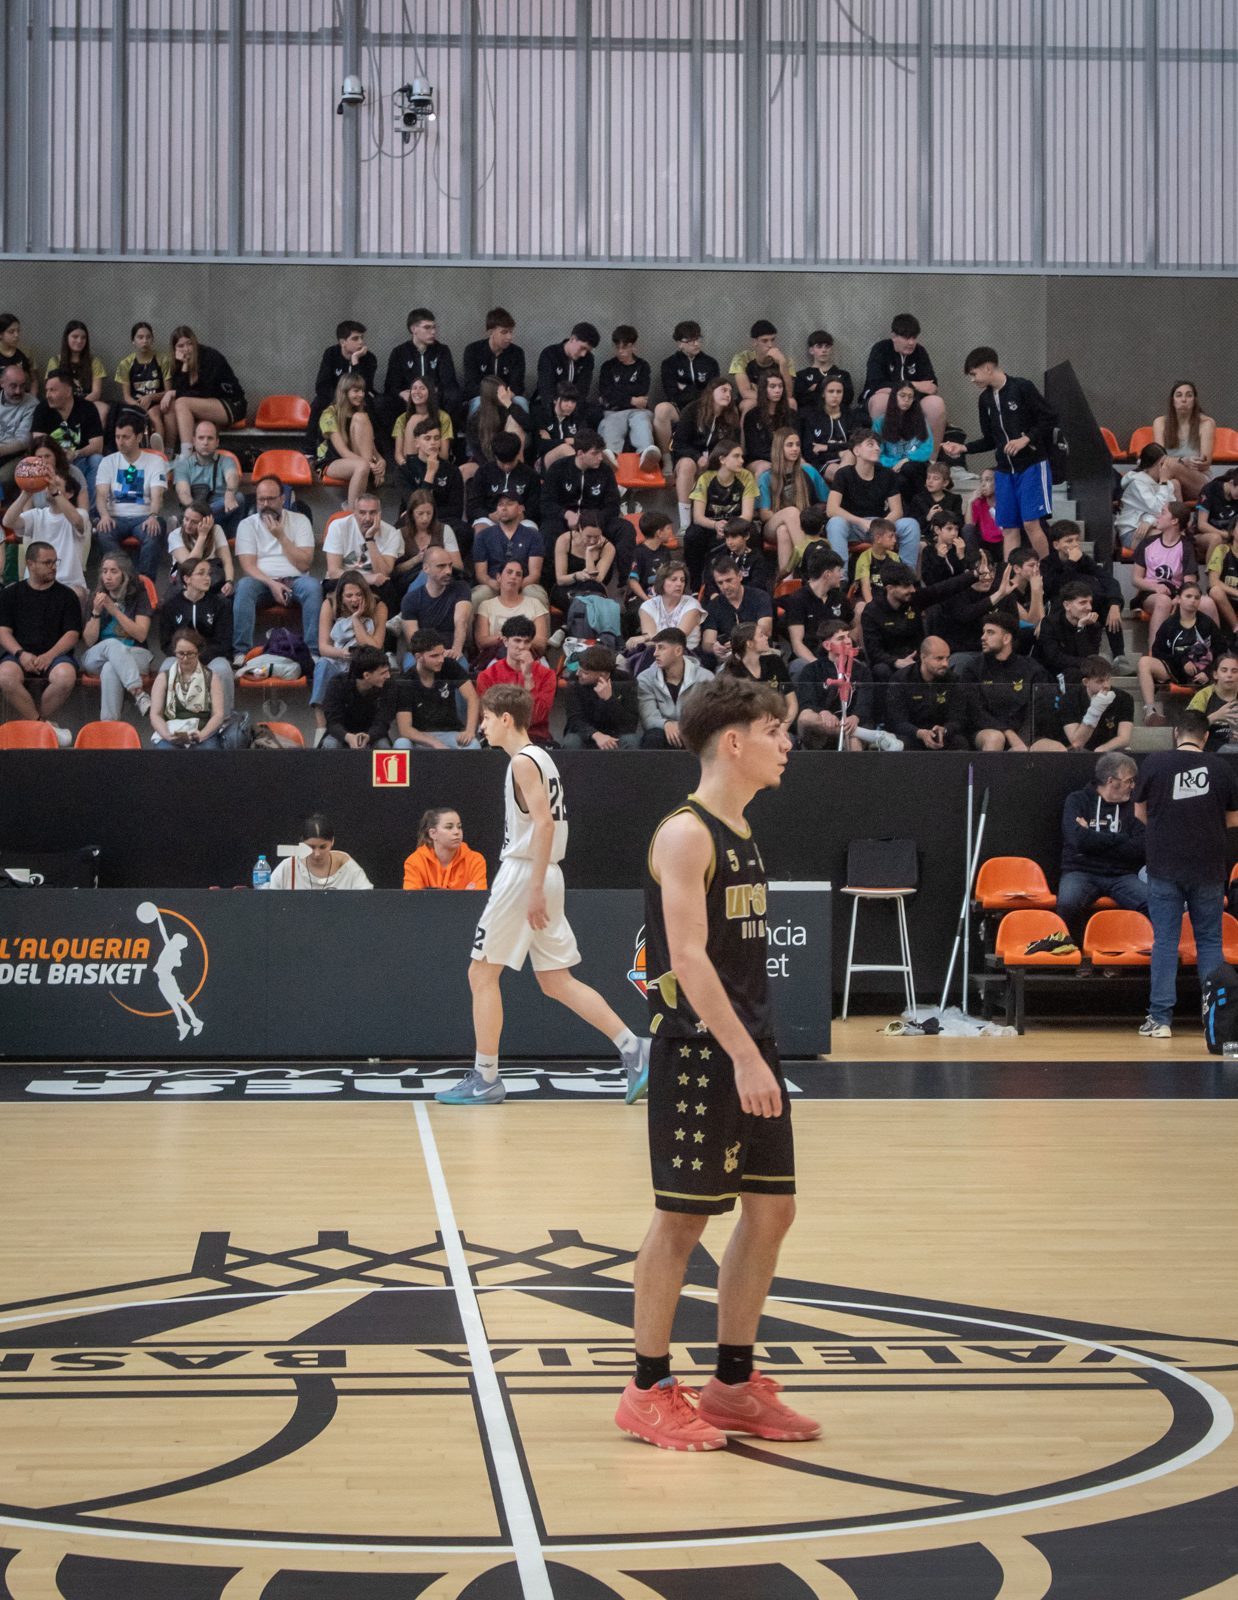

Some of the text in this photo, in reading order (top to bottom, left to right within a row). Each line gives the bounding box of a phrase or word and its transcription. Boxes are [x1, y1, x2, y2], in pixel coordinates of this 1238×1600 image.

[1179, 771, 1209, 788] R&O
[726, 849, 740, 872] 5
[0, 937, 151, 963] L'ALQUERIA
[473, 926, 486, 951] 2
[0, 963, 148, 985] DEL BASKET
